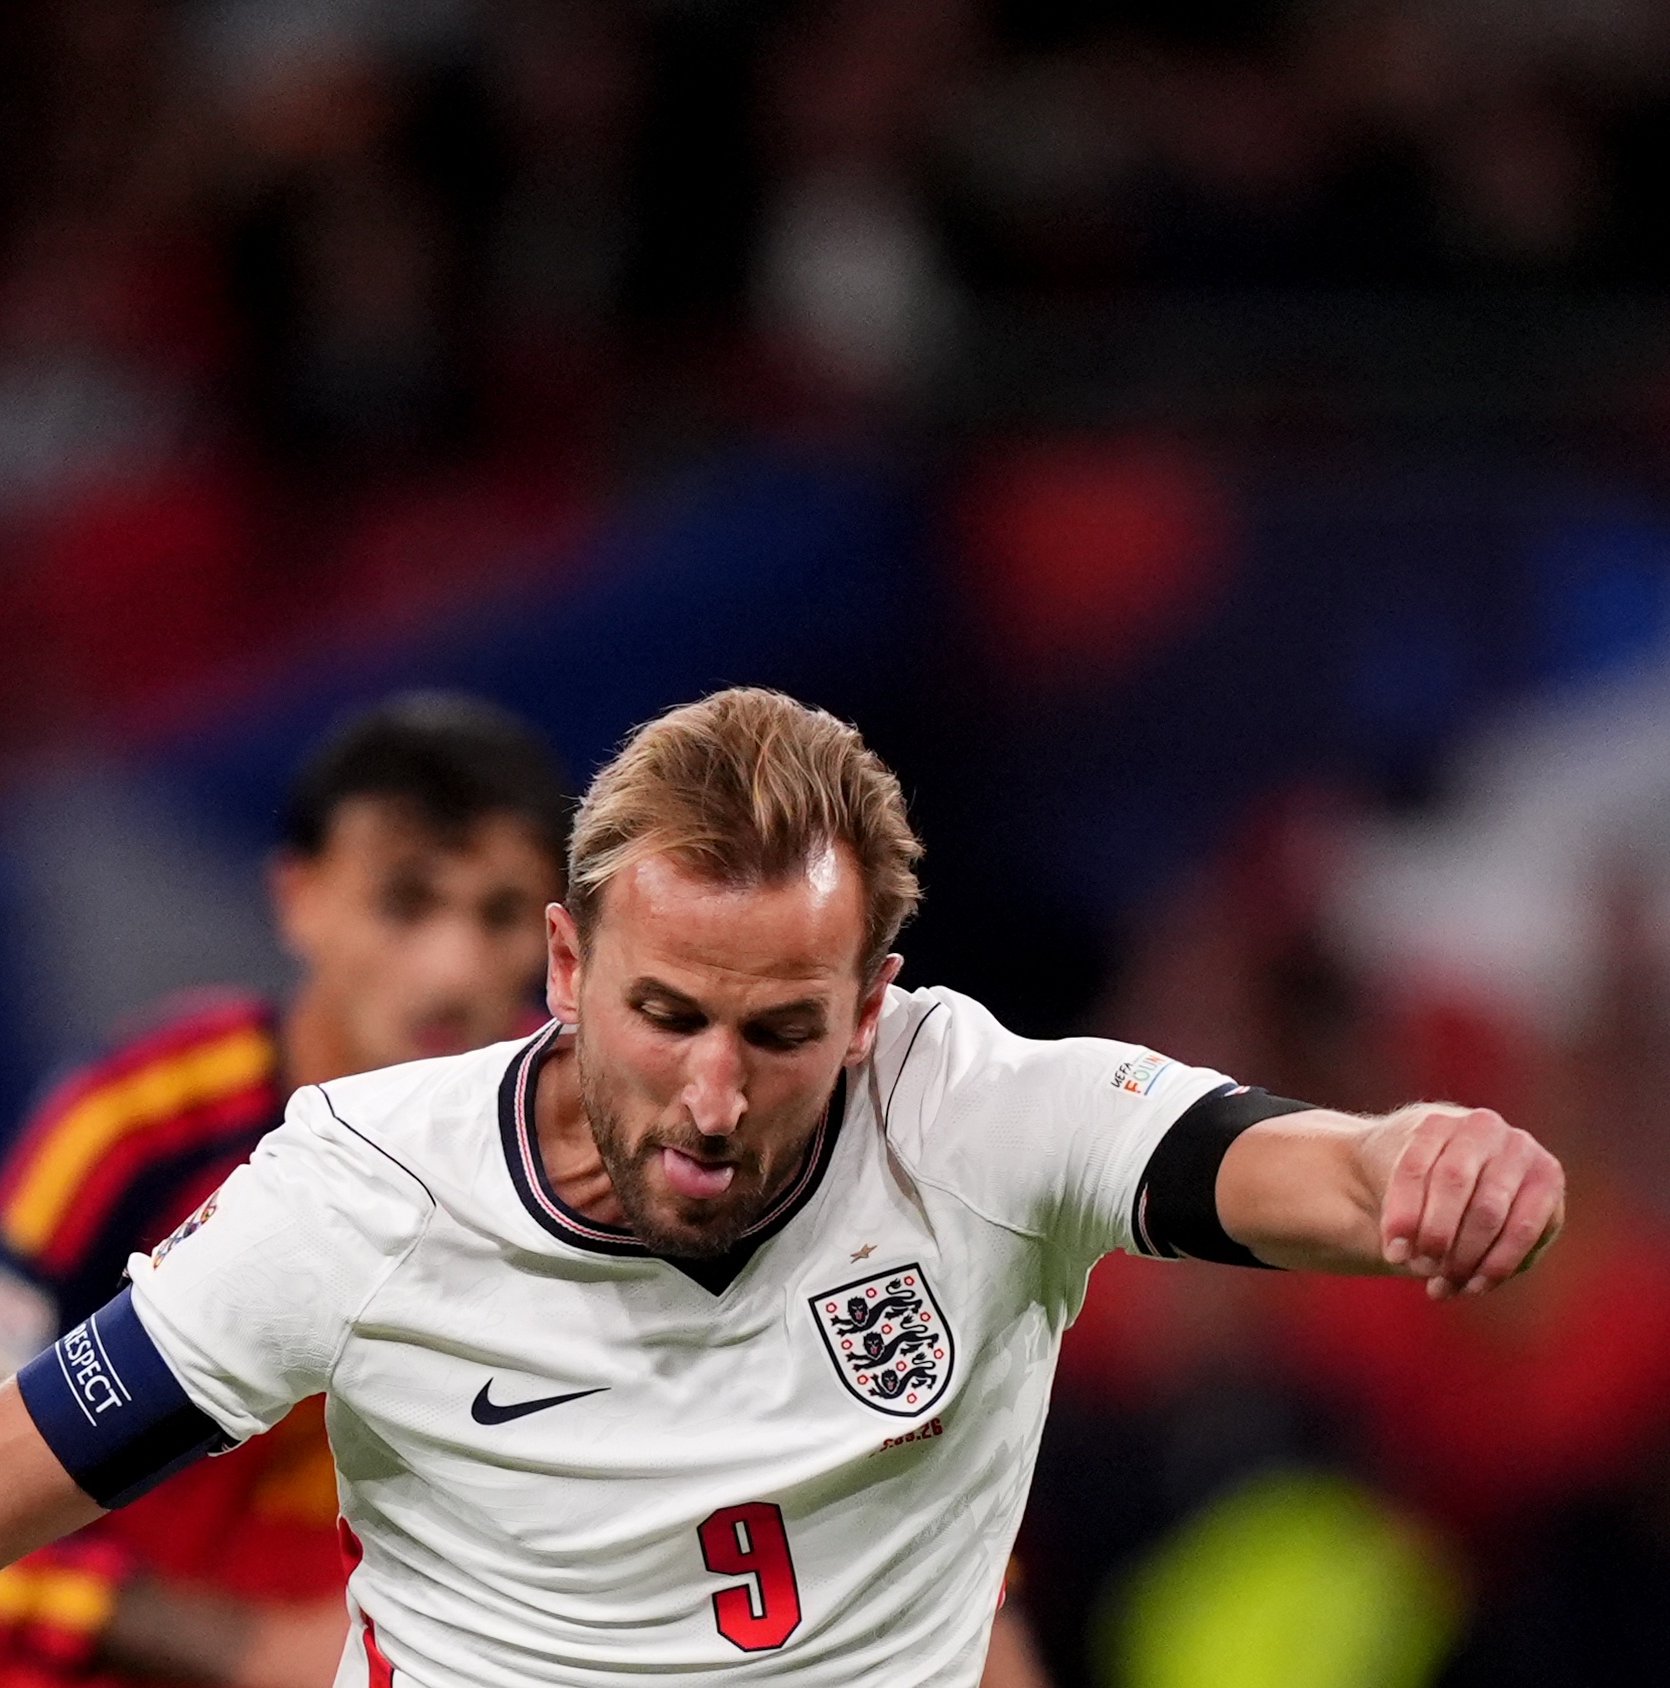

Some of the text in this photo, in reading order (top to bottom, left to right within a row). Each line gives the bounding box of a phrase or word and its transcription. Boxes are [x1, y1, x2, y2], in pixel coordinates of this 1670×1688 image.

[1110, 1061, 1134, 1089] UEFA
[63, 1322, 123, 1414] RESPECT
[697, 1501, 803, 1654] 9
